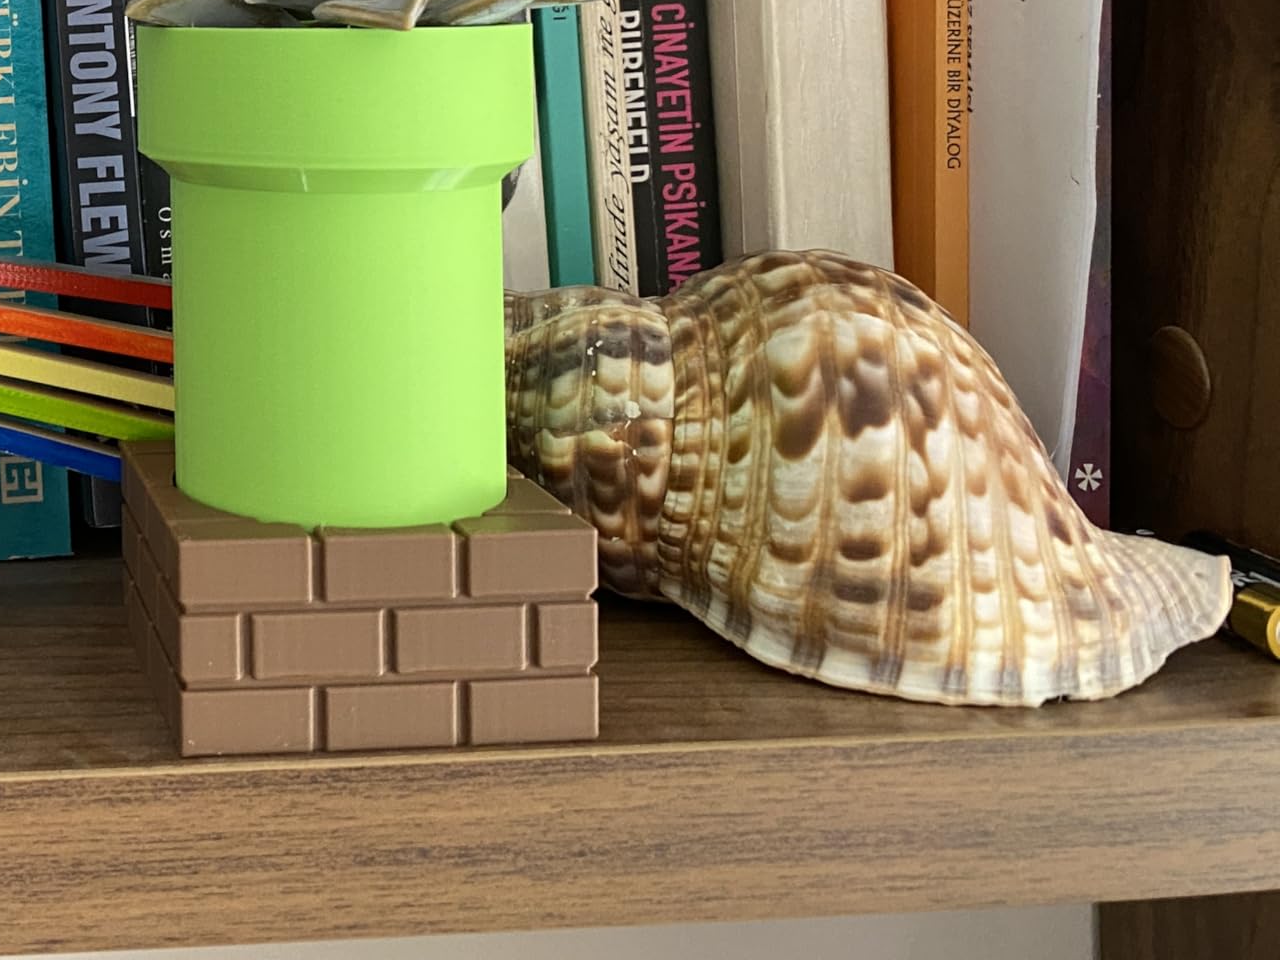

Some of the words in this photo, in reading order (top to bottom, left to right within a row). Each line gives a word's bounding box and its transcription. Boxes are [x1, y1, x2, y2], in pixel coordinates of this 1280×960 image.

[599, 15, 614, 59] ne
[651, 3, 701, 154] CİNAYETİN
[947, 69, 964, 93] BİR
[947, 98, 965, 170] DİYALOG
[77, 154, 132, 275] FLEW
[661, 162, 706, 291] PSİKANA
